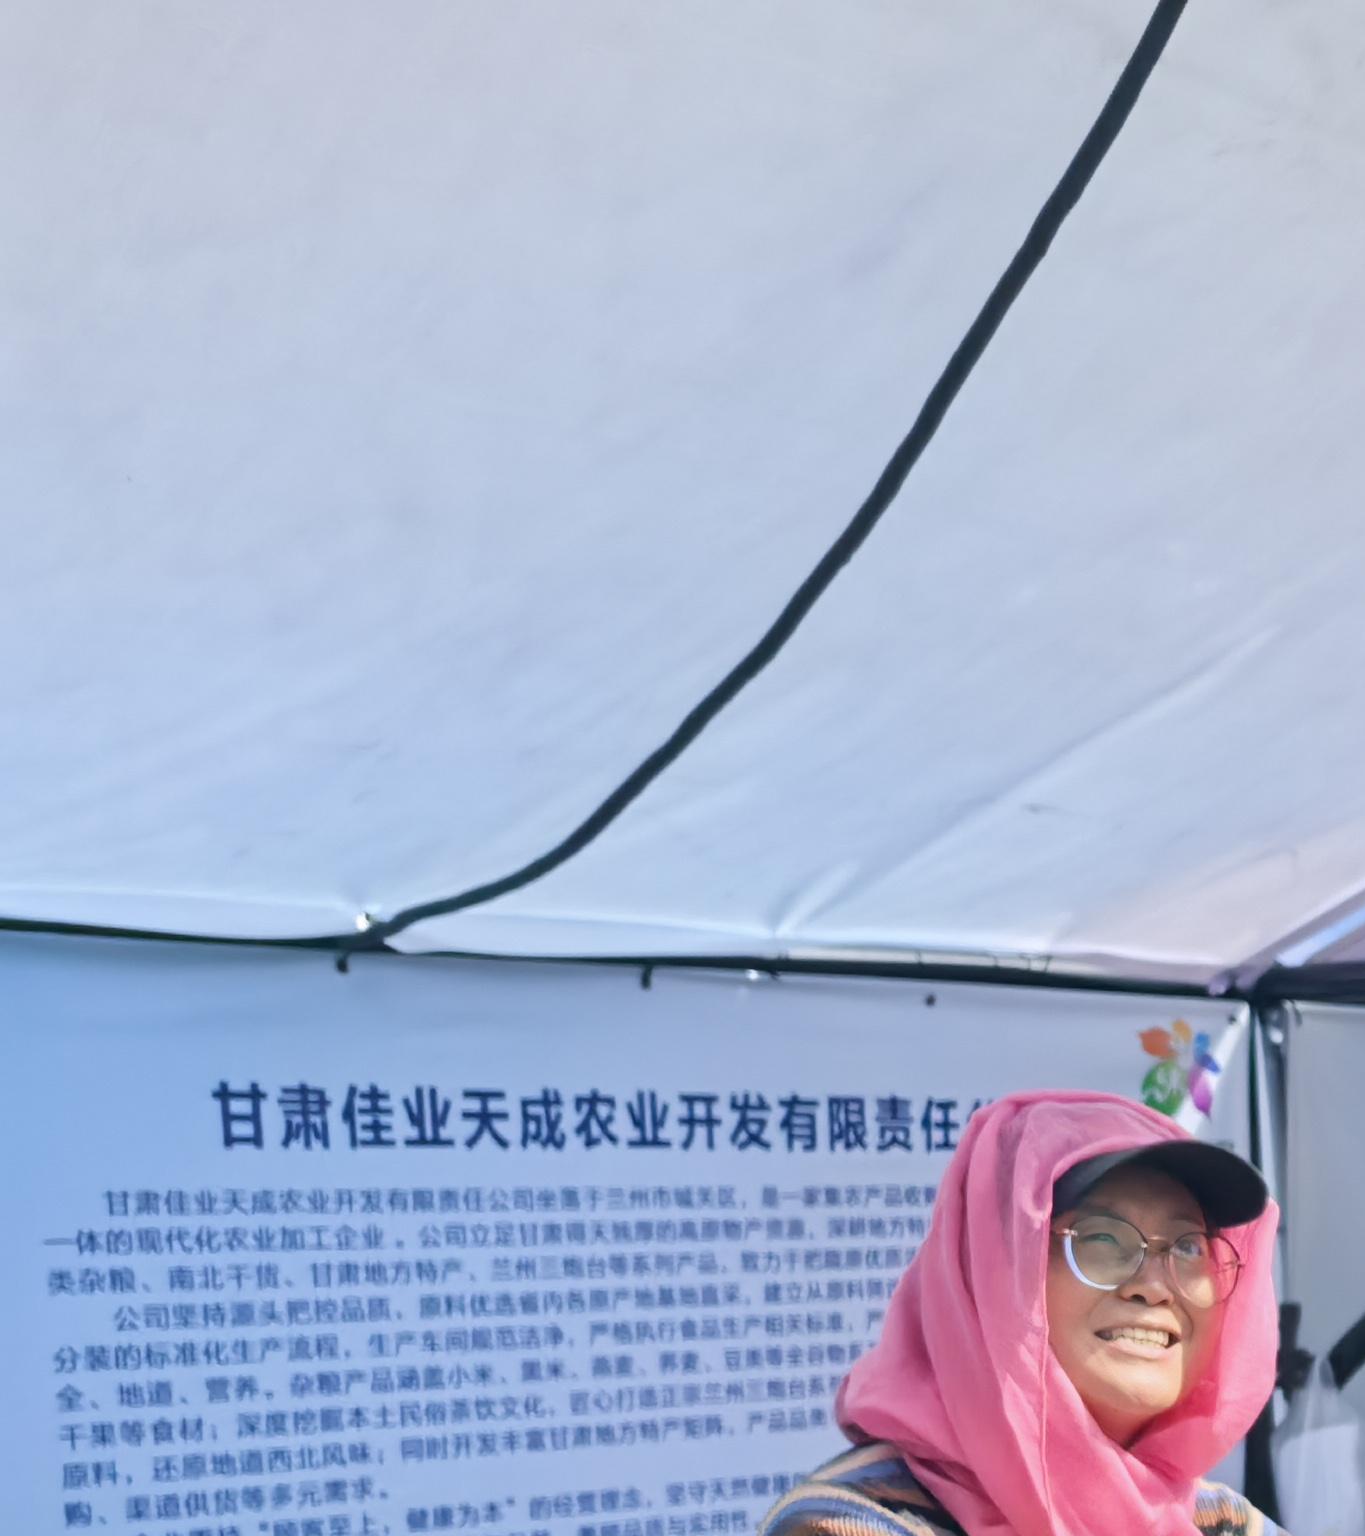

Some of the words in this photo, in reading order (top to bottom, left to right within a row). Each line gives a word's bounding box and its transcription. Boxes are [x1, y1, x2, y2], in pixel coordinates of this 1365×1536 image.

[211, 1079, 996, 1153] 甘肃佳业天成农业开发有限责任
